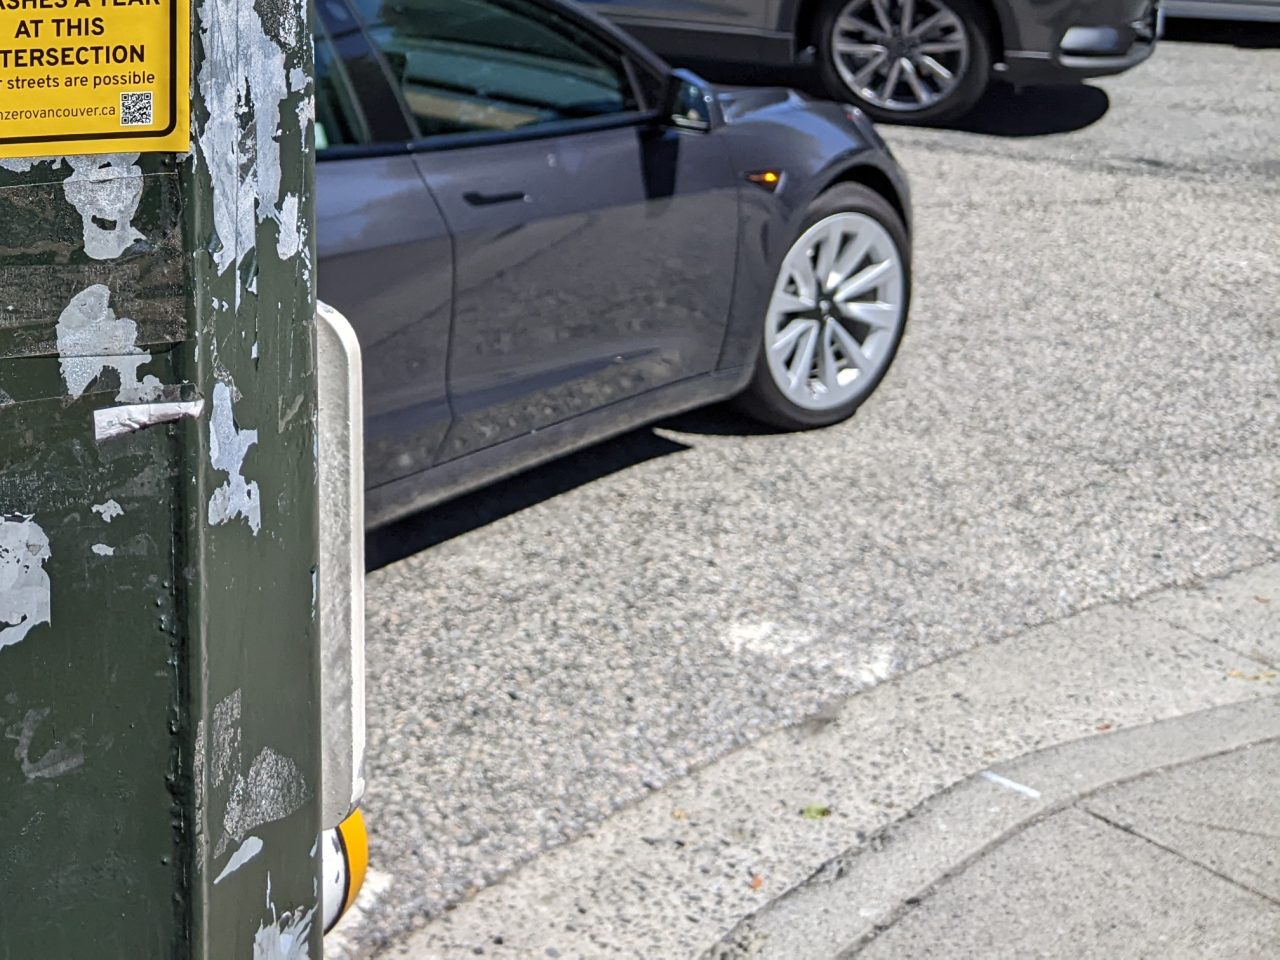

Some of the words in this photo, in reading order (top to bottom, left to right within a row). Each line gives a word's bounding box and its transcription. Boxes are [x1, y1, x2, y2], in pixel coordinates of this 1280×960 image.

[15, 20, 43, 38] AT
[52, 17, 104, 36] THIS
[8, 75, 59, 89] streets
[65, 77, 88, 87] are
[94, 71, 154, 88] possible
